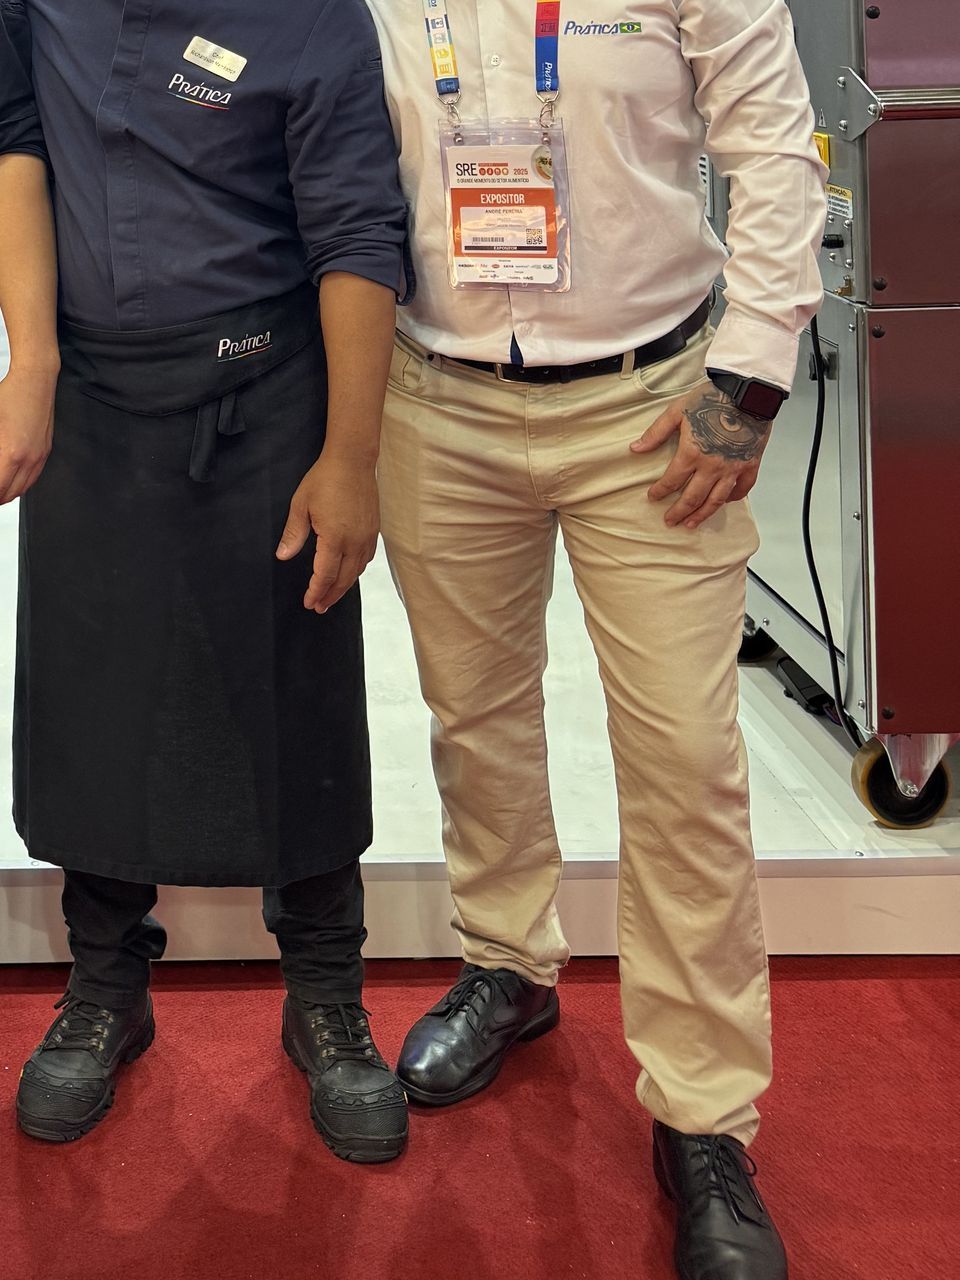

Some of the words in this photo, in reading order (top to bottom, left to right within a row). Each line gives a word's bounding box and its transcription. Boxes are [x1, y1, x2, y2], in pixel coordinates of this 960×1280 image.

[564, 20, 619, 35] PRÁTICA
[168, 73, 232, 104] PRÁTICA
[455, 163, 478, 176] SRE
[480, 193, 525, 204] EXPOSITOR
[217, 331, 271, 357] PRÁTICA
